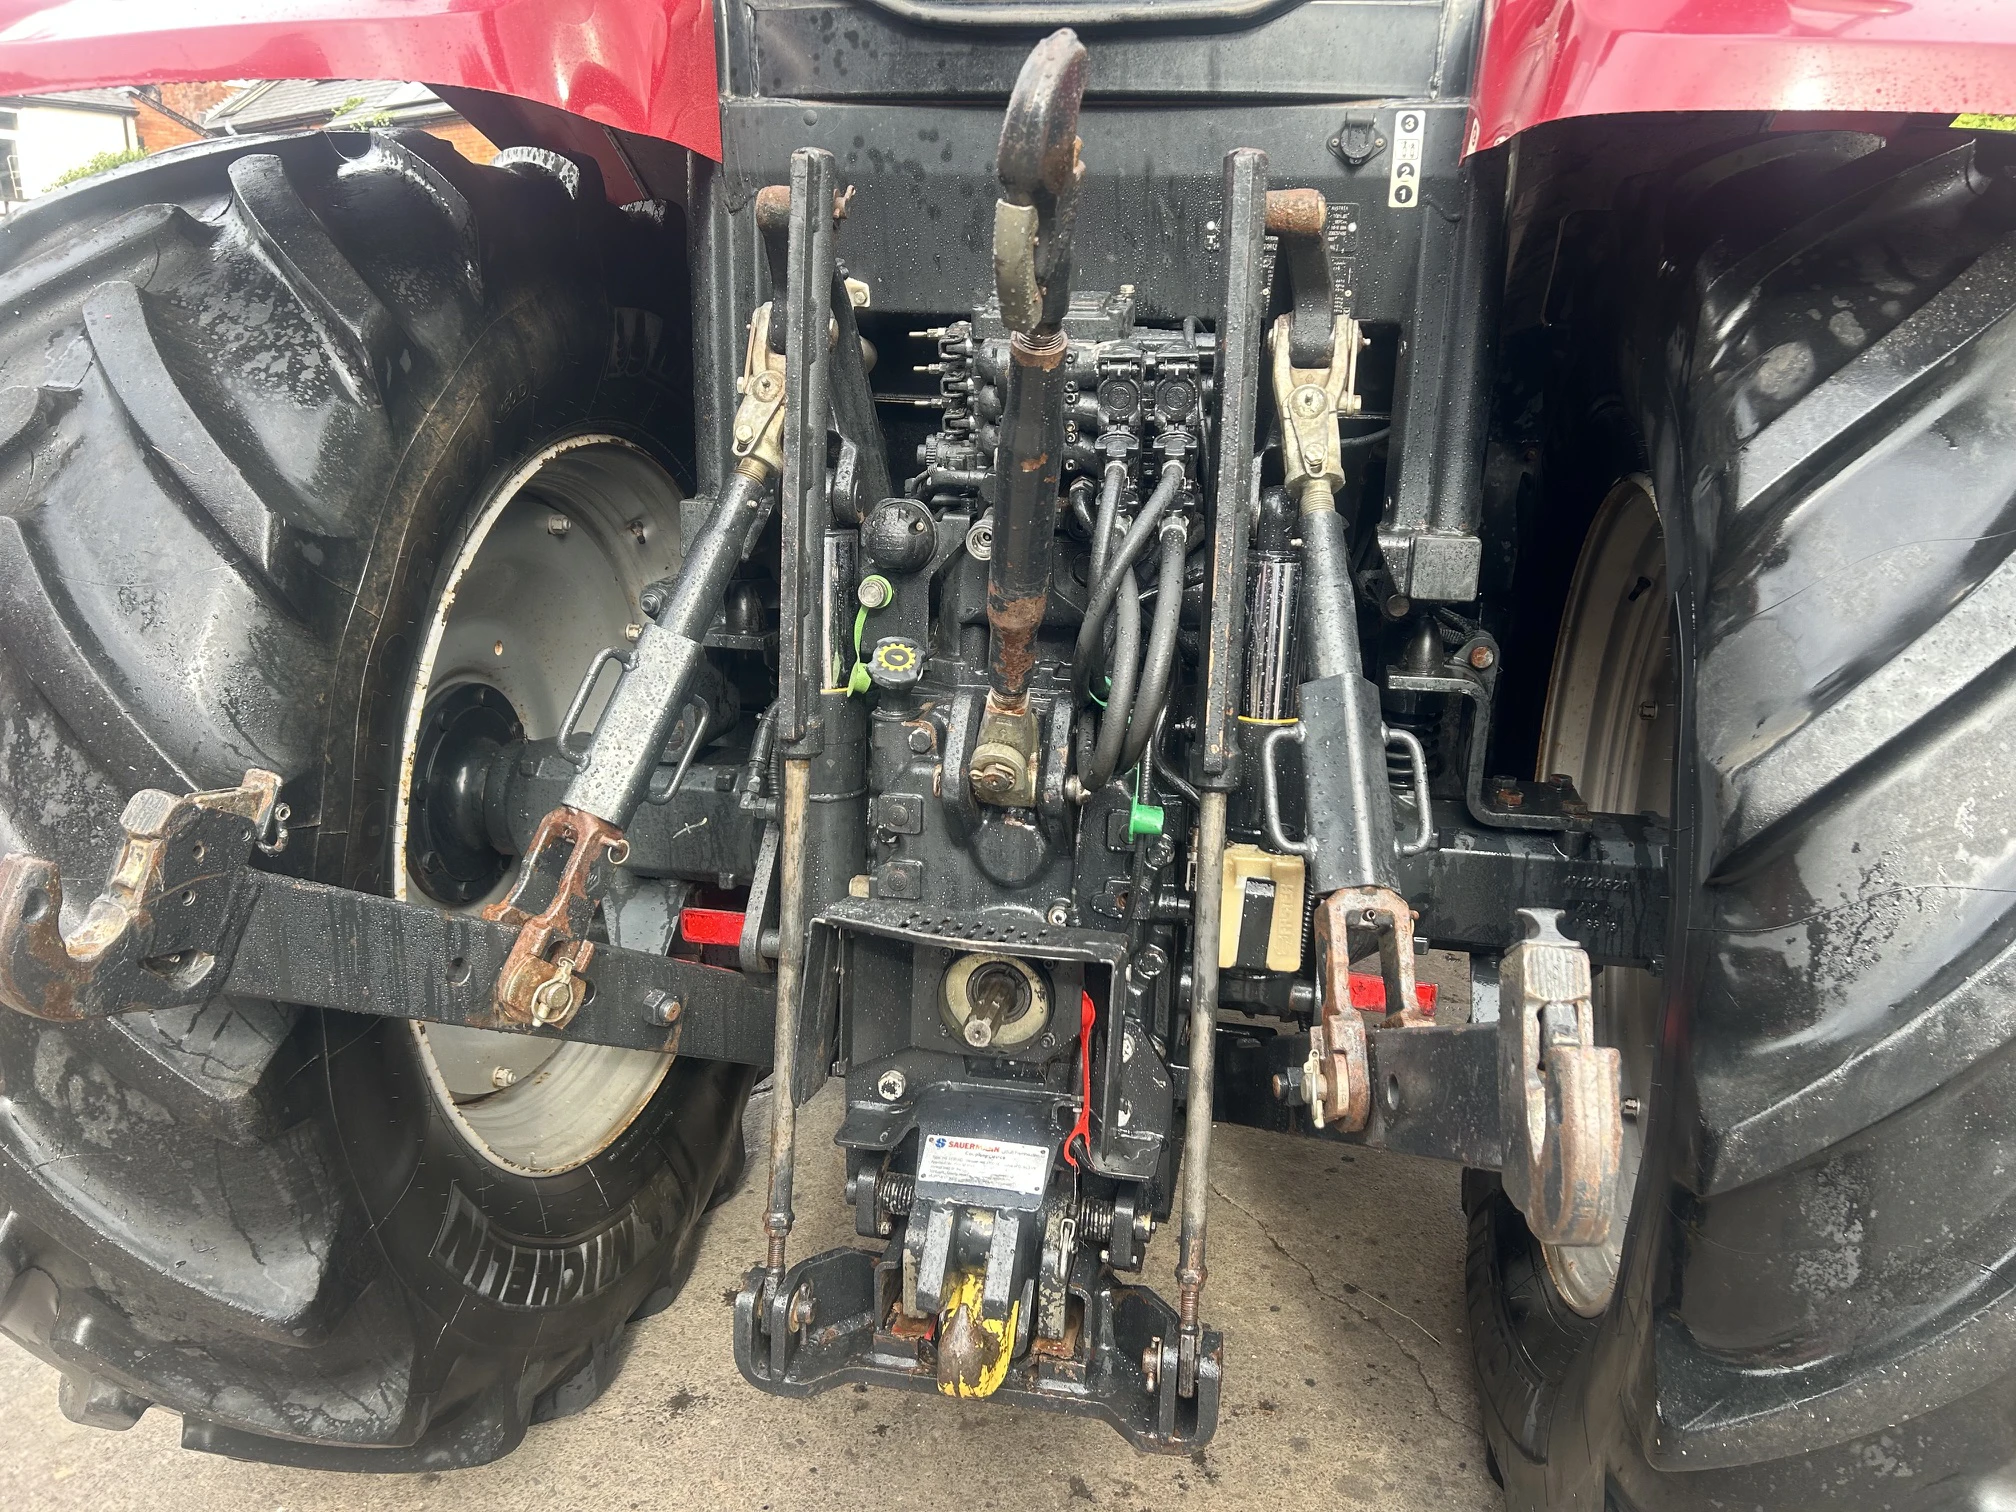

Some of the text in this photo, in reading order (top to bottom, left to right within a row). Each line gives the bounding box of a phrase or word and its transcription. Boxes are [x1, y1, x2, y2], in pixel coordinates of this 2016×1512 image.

[1404, 117, 1415, 130] 3
[1399, 188, 1407, 200] 1
[948, 1141, 1000, 1153] SAUERMN
[438, 1198, 637, 1307] MICHELIN
